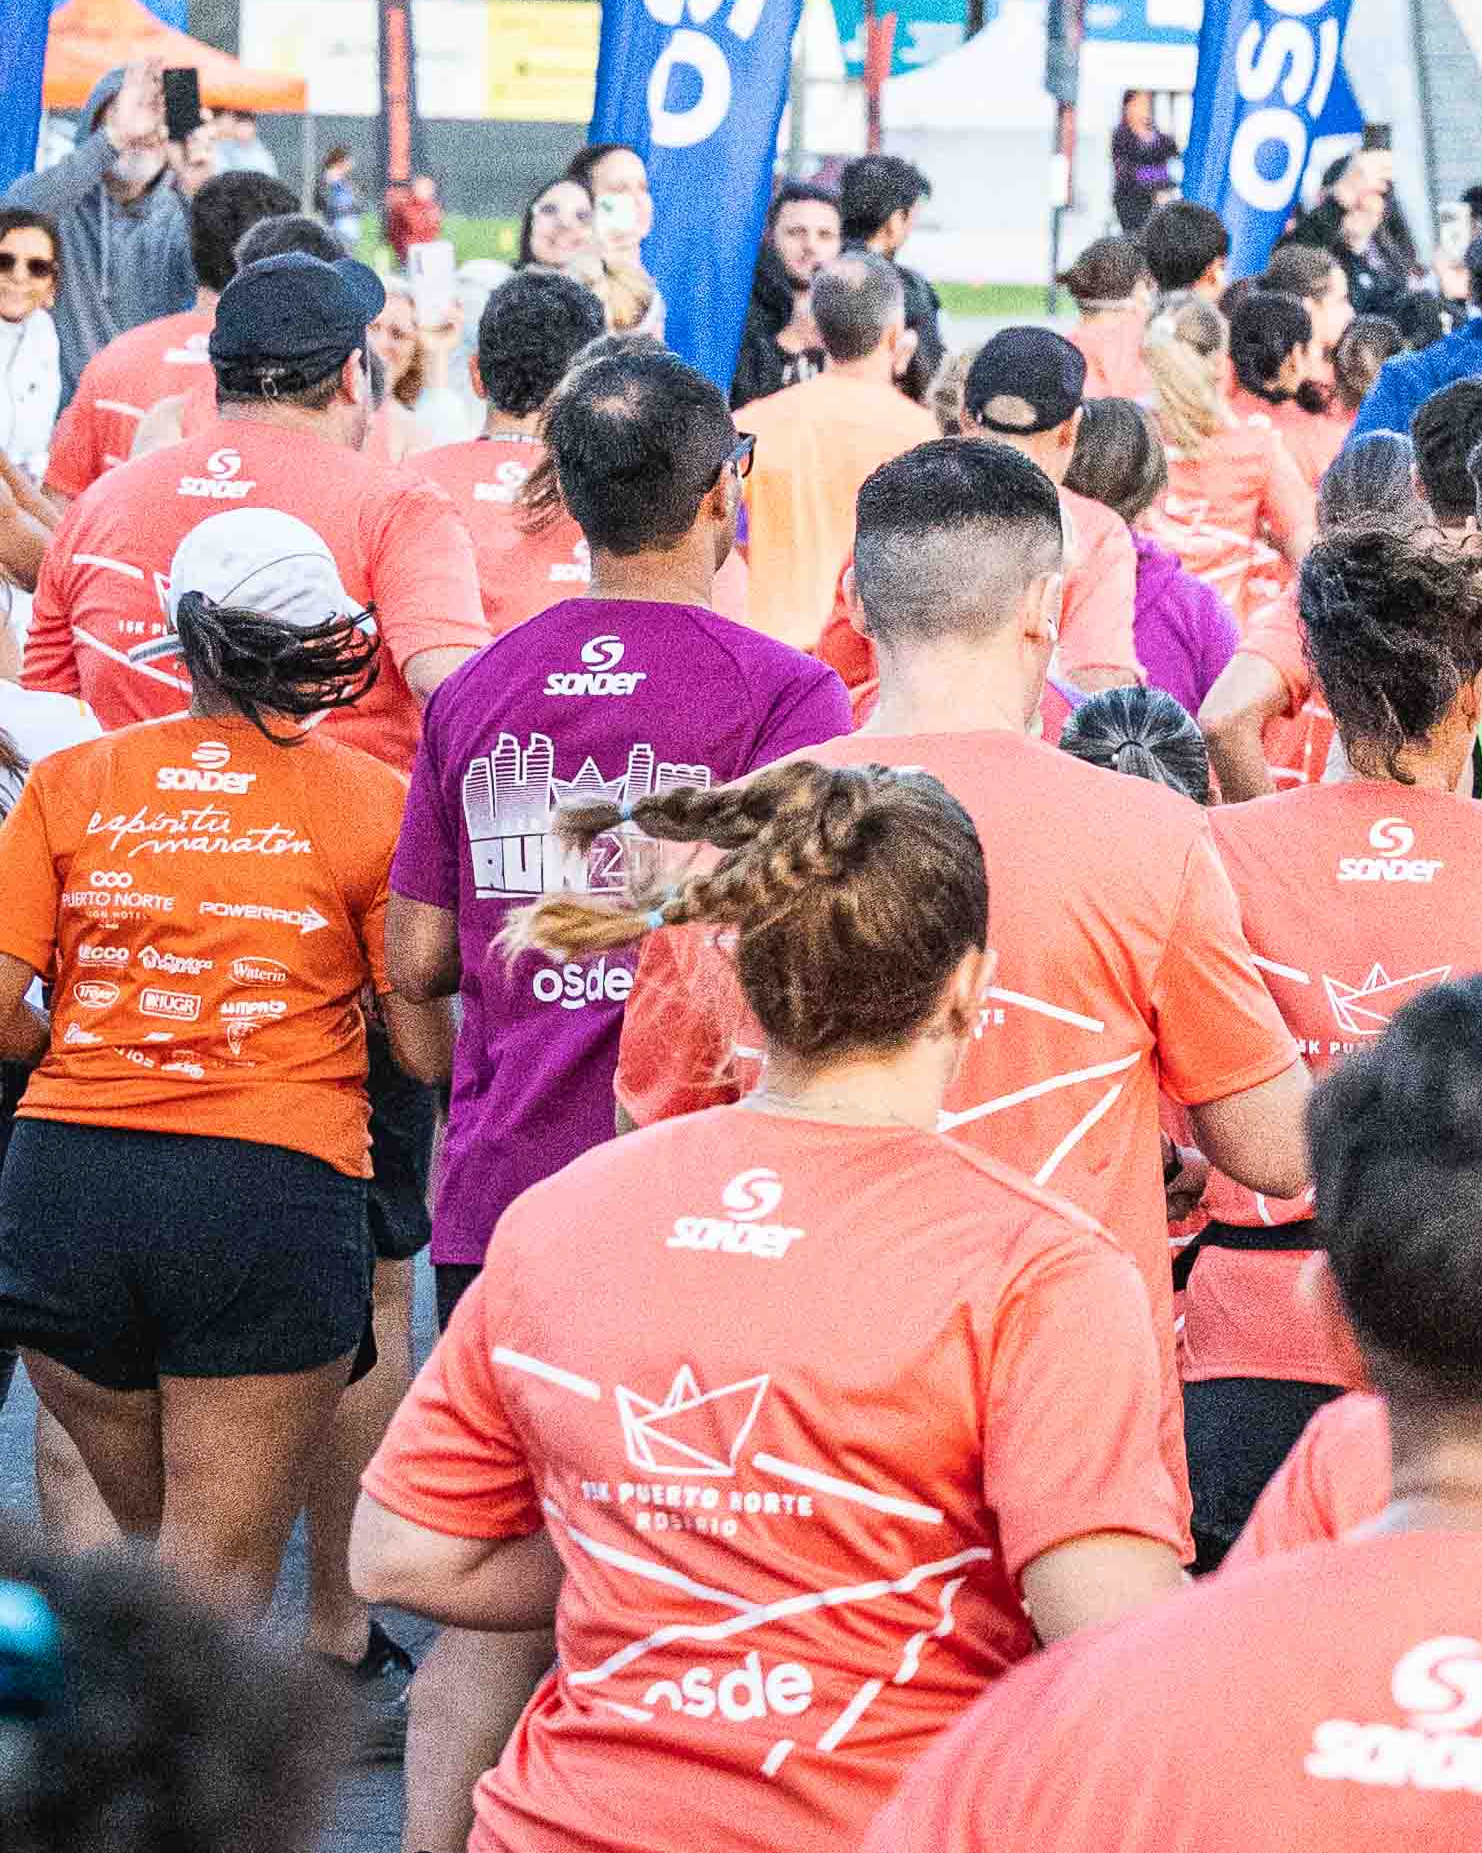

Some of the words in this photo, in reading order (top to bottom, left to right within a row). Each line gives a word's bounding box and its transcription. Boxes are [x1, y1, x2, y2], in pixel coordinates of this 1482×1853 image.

[113, 890, 176, 912] NORTE
[532, 955, 636, 1010] osde
[618, 1481, 721, 1509] PUERTO
